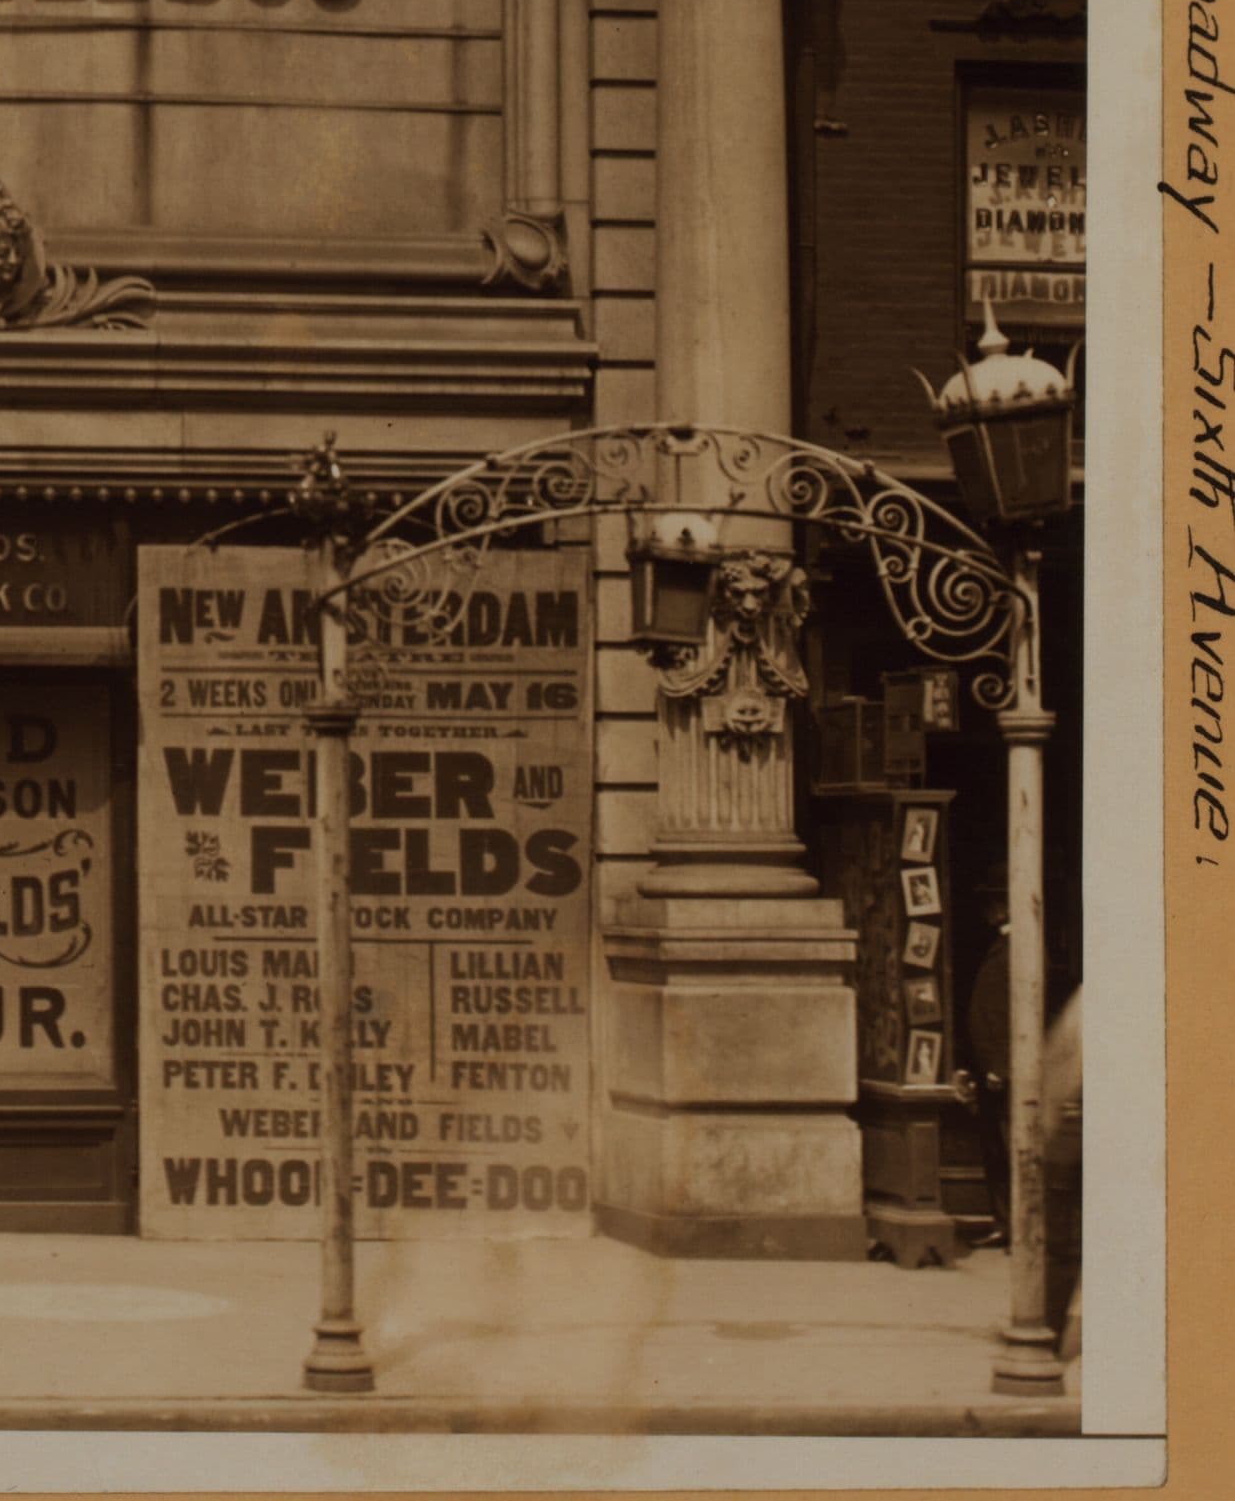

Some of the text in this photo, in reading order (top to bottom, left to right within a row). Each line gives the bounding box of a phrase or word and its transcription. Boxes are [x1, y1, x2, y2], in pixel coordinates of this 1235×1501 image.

[1188, 322, 1234, 512] Sixth
[160, 588, 245, 645] NEW
[160, 678, 177, 708] 2
[188, 678, 267, 708] WEEKS
[426, 681, 514, 710] MAY
[526, 682, 579, 712] 16
[377, 726, 499, 740] TOGETHER
[513, 764, 564, 801] AND
[250, 825, 582, 898] FELDS
[426, 907, 558, 933] COMPANY
[161, 949, 355, 980] LOUIS MA
[449, 952, 564, 980] LILLIAN
[161, 982, 374, 1015] CHAS. J. RS
[450, 986, 585, 1015] RUSSELL
[161, 1018, 393, 1050] JOHN T. KLY
[450, 1023, 557, 1053] MABEL
[162, 1060, 259, 1091] PETER
[272, 1062, 298, 1091] F.
[450, 1061, 571, 1092] FENTON
[355, 1111, 420, 1141] AND
[438, 1113, 543, 1143] FIELDS
